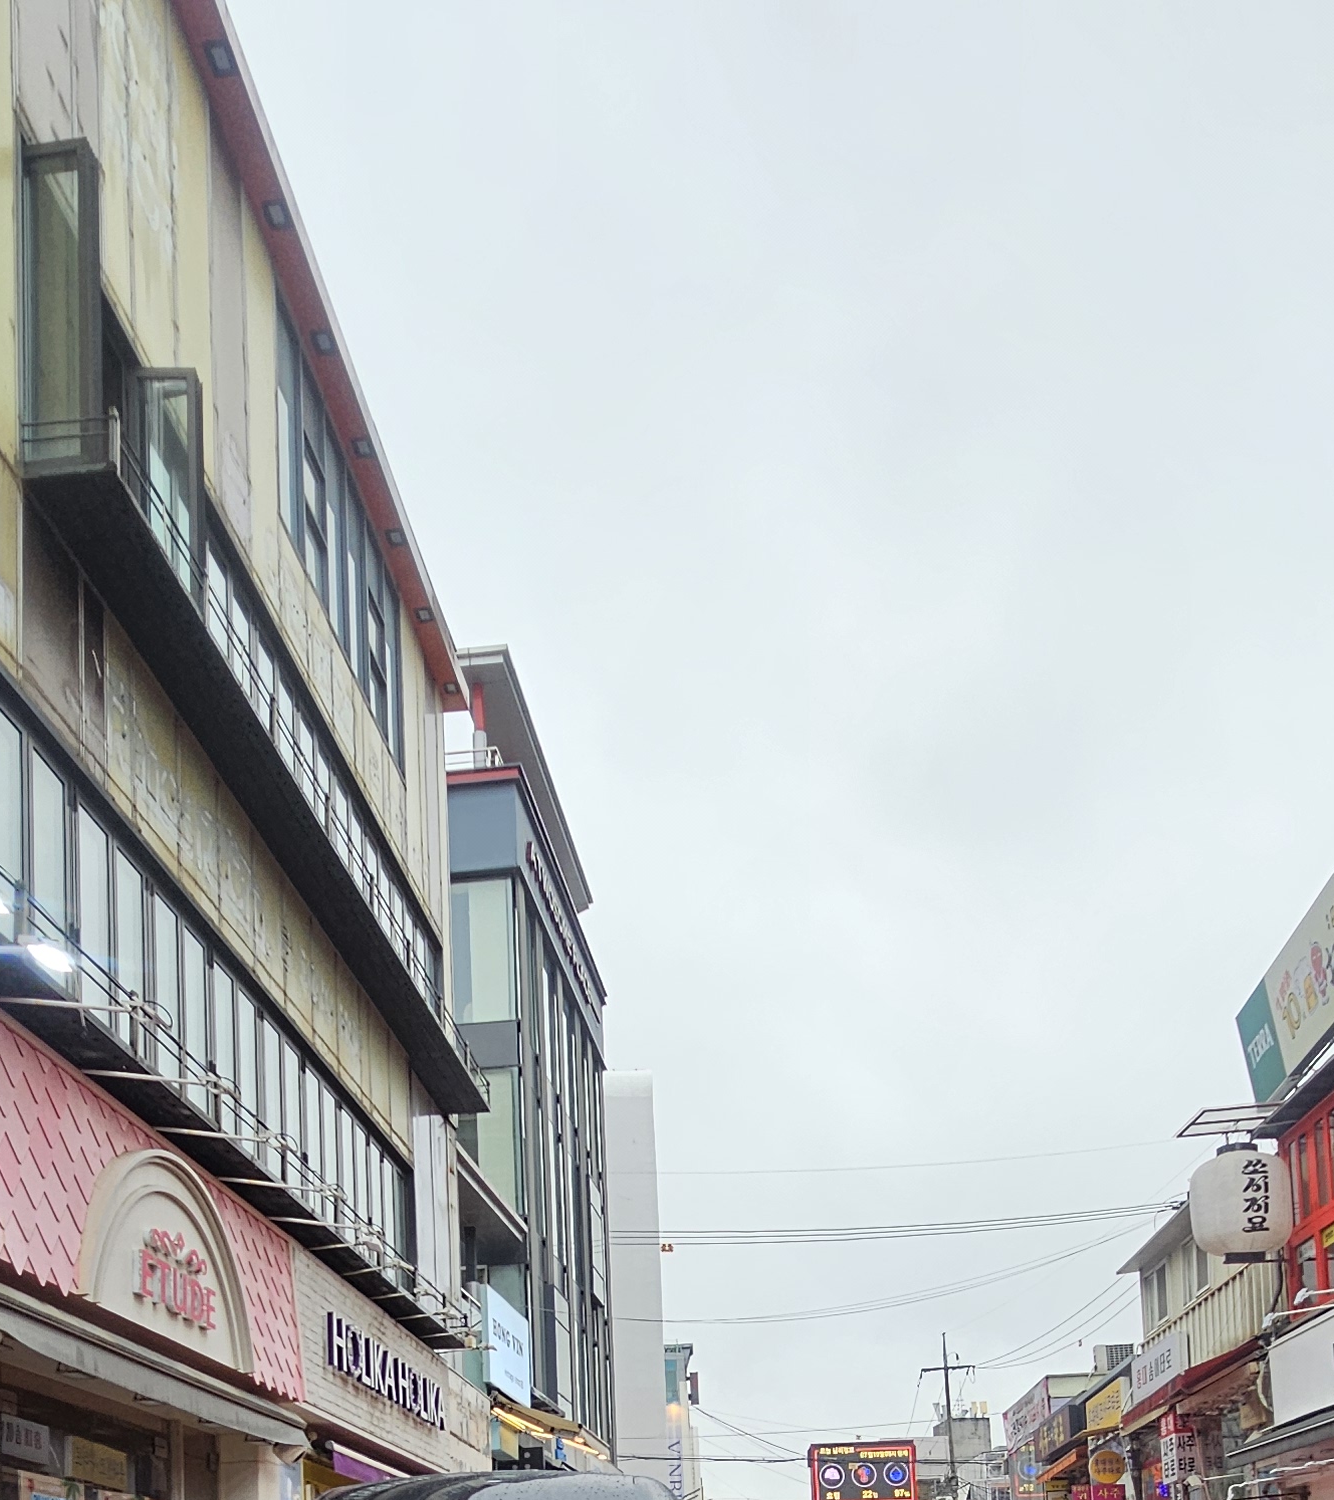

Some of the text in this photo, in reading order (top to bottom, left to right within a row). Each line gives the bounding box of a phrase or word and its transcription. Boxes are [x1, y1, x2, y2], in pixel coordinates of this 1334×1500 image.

[132, 1248, 217, 1333] ETUDE
[324, 1310, 448, 1432] HOLIKA HOLIKA
